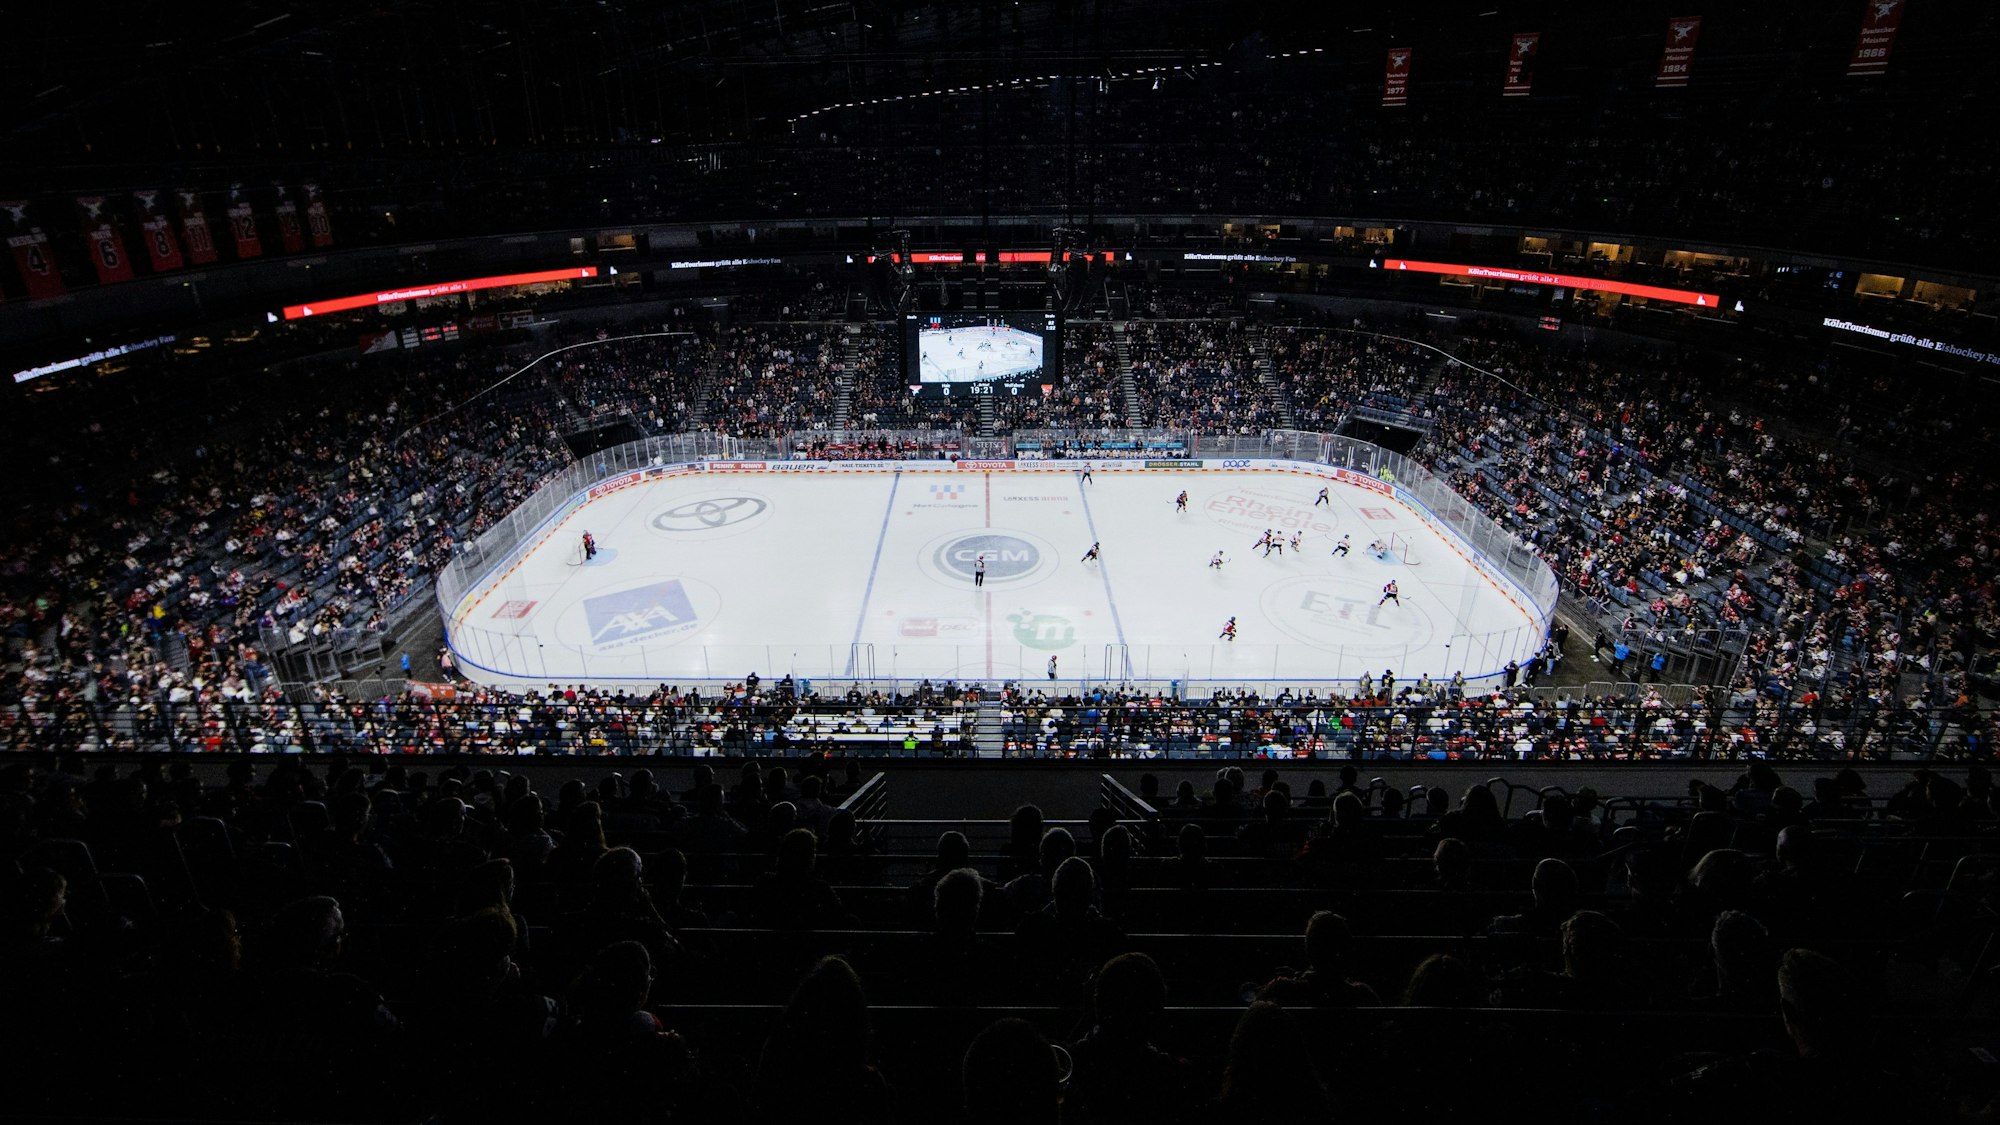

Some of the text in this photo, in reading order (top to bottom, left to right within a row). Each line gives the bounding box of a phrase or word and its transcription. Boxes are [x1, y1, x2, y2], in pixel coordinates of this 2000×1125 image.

[1860, 27, 1896, 35] Deutscher
[1663, 64, 1687, 72] 1984
[232, 215, 258, 241] 12
[154, 229, 171, 257] 8
[28, 243, 50, 276] 4
[97, 239, 120, 269] 6
[1184, 253, 1227, 261] KölnTourismus
[1227, 254, 1244, 262] grüßt
[671, 260, 715, 269] KölnTourismus
[715, 259, 732, 268] grüßt
[1468, 268, 1519, 279] KölnTourismus
[1520, 273, 1539, 282] grüßt
[1540, 275, 1553, 283] alle
[377, 288, 430, 302] KölnTourismus
[450, 284, 462, 292] alle
[1823, 318, 1890, 338] KölnTourismus
[1889, 333, 1916, 345] grüßt
[1916, 338, 1934, 349] alle
[1935, 341, 1986, 362] Eishockey
[105, 347, 120, 359] alle
[943, 387, 950, 396] 0
[970, 386, 993, 394] 19:21
[1011, 387, 1018, 396] 0
[605, 475, 634, 490] TOYOTA
[1358, 475, 1386, 490] TOYOTA
[1227, 495, 1313, 520] Rhein
[1207, 500, 1332, 532] Energie
[955, 550, 1029, 562] CGM
[592, 604, 680, 641] AXA
